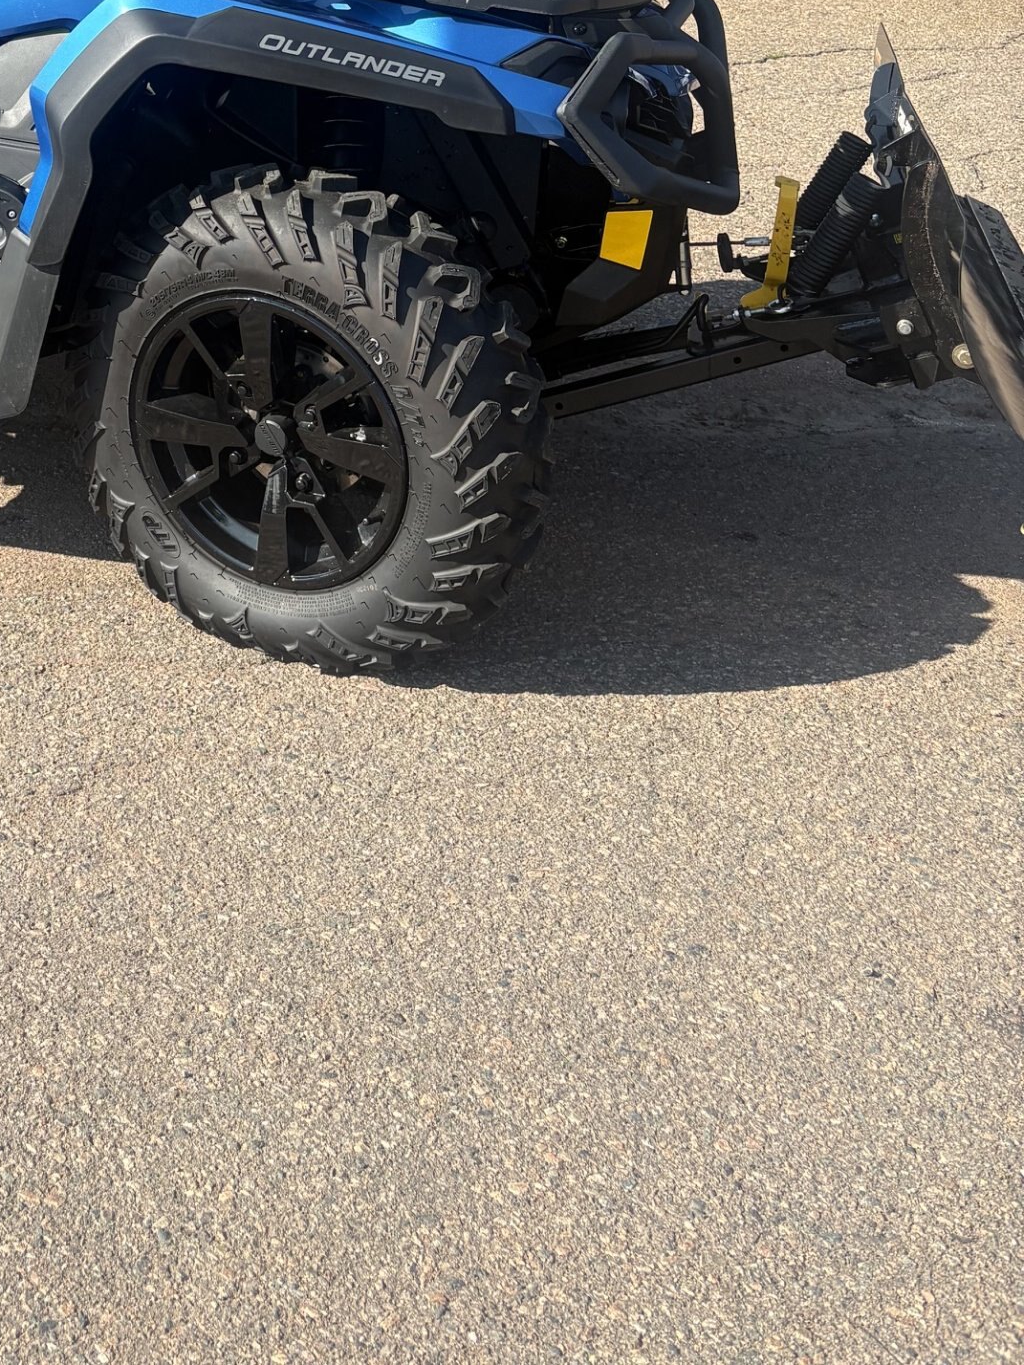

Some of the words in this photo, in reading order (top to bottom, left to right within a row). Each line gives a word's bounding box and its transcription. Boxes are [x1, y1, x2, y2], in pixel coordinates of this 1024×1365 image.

[258, 33, 446, 87] OUTLANDER
[281, 275, 342, 323] TERRA
[341, 315, 399, 379] CROSS
[142, 515, 177, 552] ITP
